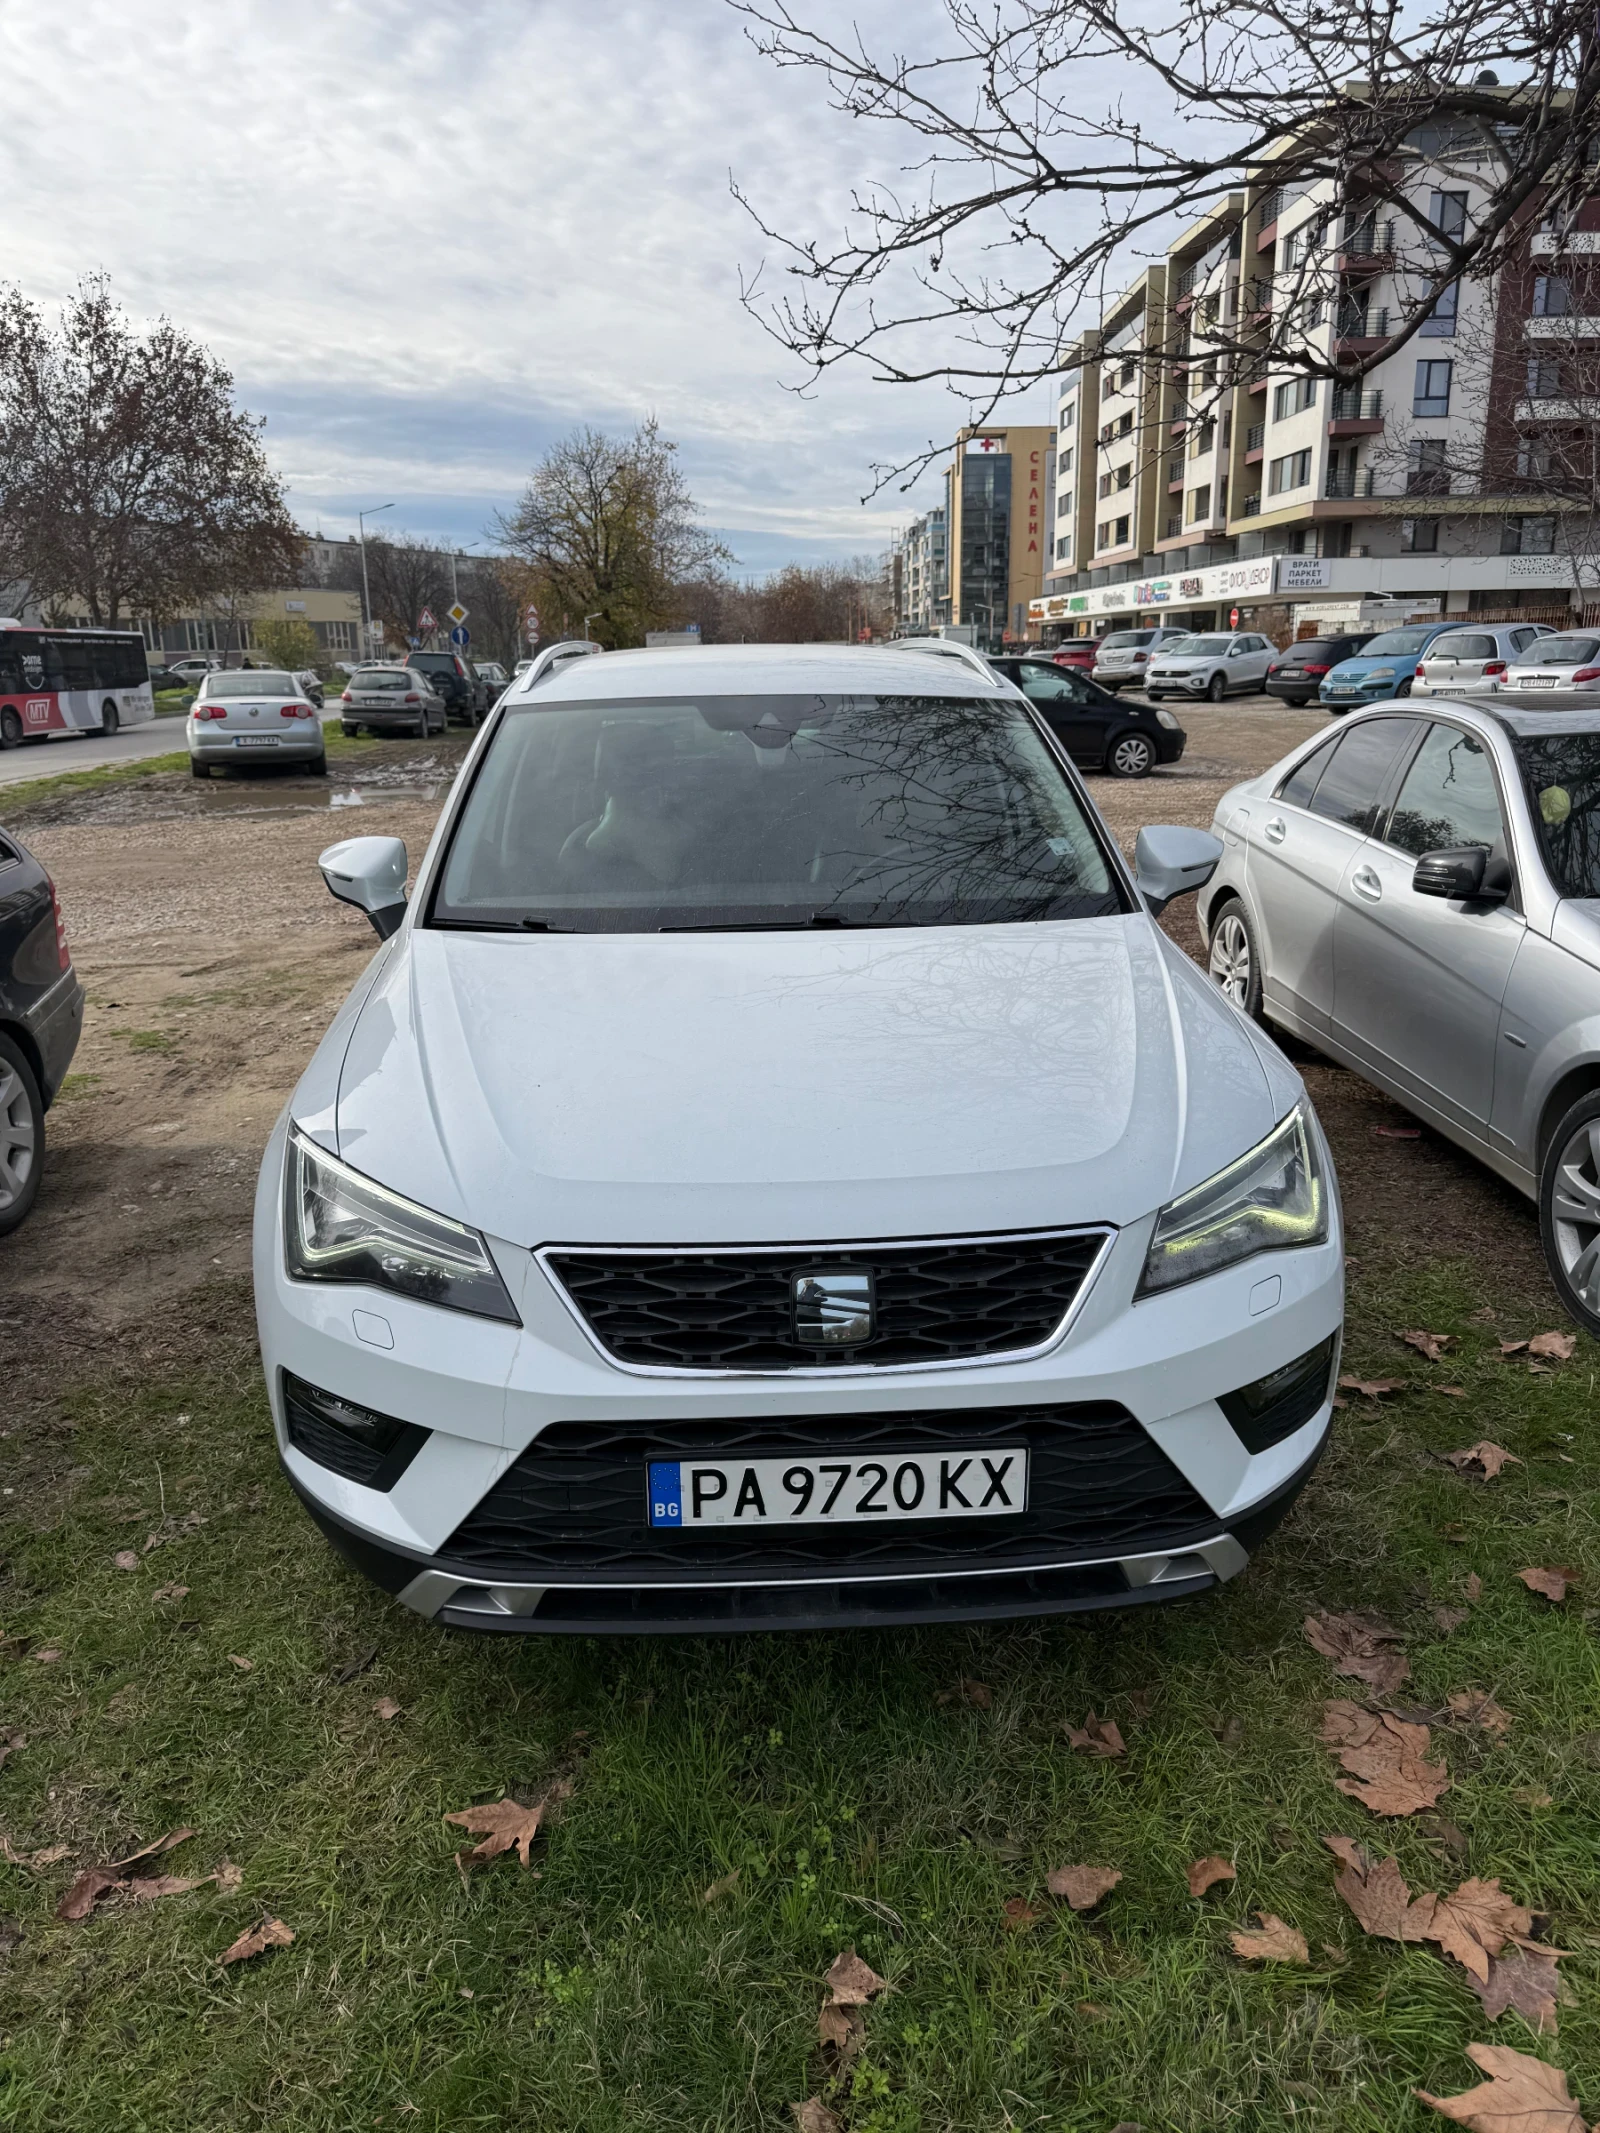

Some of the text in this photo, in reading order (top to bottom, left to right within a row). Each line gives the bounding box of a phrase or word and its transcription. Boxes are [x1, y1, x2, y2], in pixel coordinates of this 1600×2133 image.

[1028, 451, 1039, 552] СЕЛЕНА
[1292, 561, 1320, 569] ВРАТИ
[1288, 569, 1322, 578] ПАРКЕТ
[1287, 578, 1322, 587] МЕБЕЛИ
[691, 1456, 1015, 1518] PA 9720 KX
[654, 1502, 679, 1518] BG
